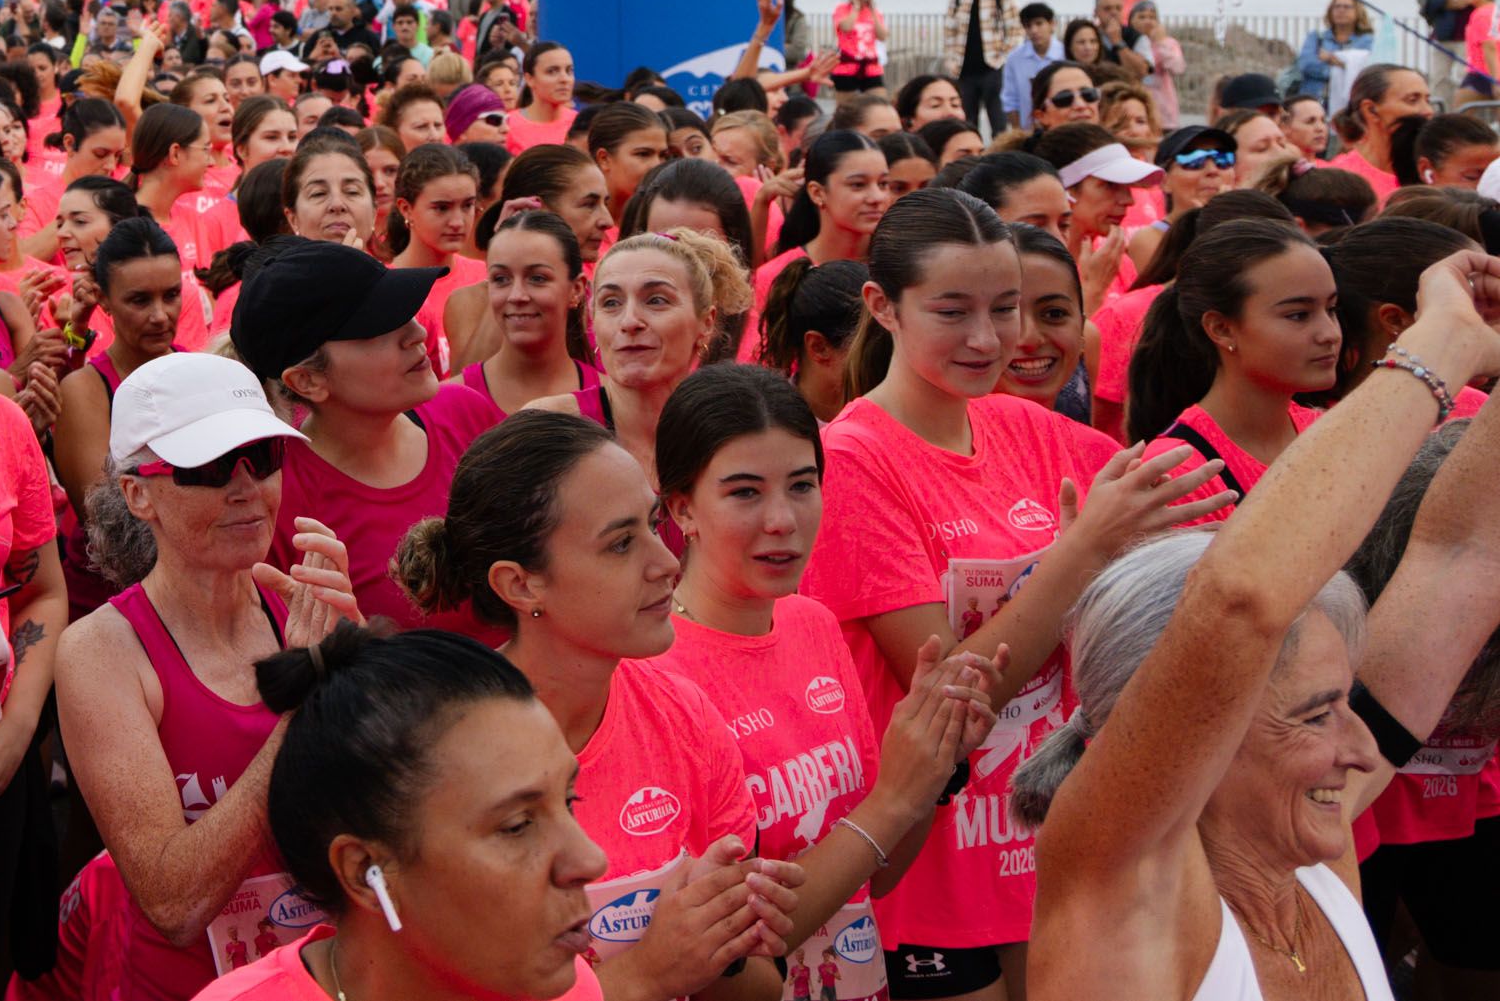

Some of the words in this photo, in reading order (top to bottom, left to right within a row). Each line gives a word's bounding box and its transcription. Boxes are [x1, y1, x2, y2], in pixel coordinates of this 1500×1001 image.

[966, 577, 1004, 587] SUMA
[745, 735, 865, 831] CARRERA
[1423, 775, 1459, 799] 2026
